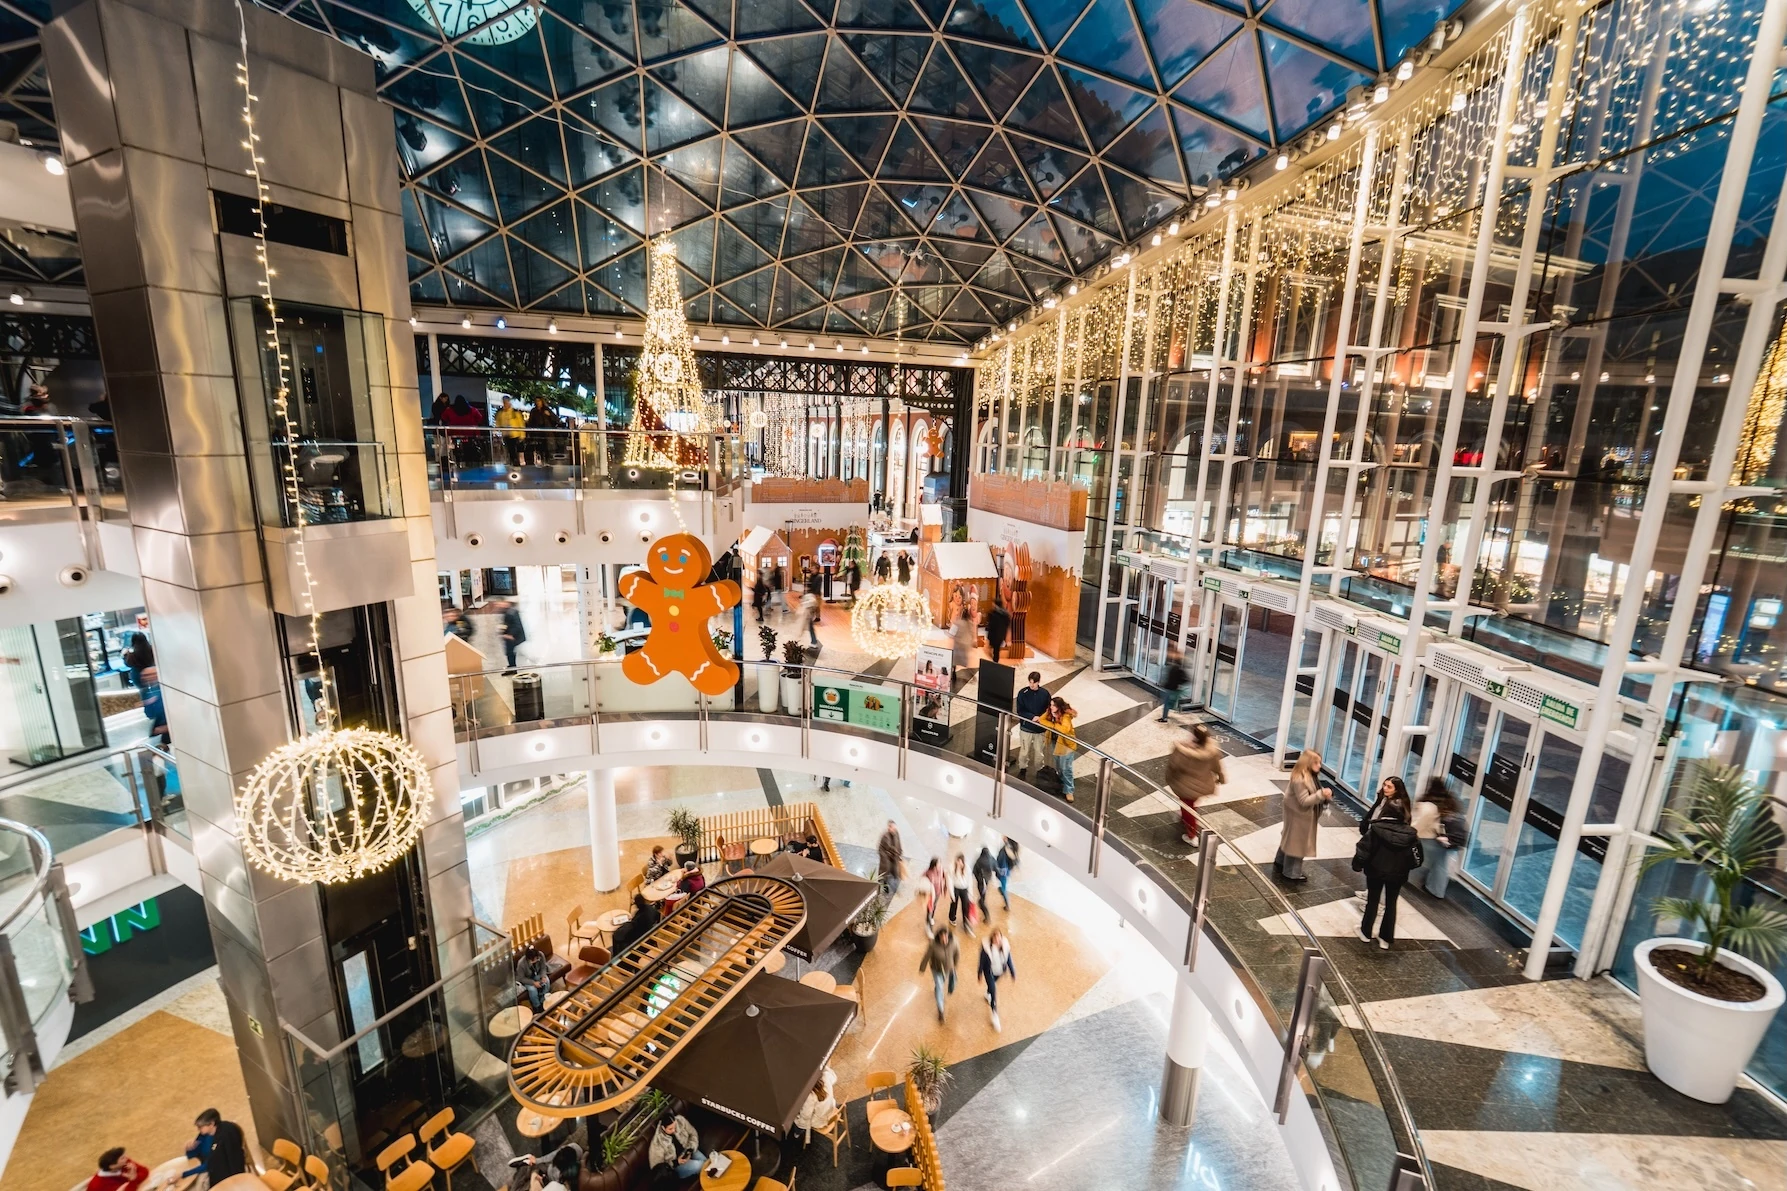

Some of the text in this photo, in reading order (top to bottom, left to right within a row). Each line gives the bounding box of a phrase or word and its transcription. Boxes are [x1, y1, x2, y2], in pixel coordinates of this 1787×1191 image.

[439, 2, 452, 23] 7
[786, 944, 808, 958] COFFEE
[701, 1097, 776, 1134] STARBUCKS COFFEE
